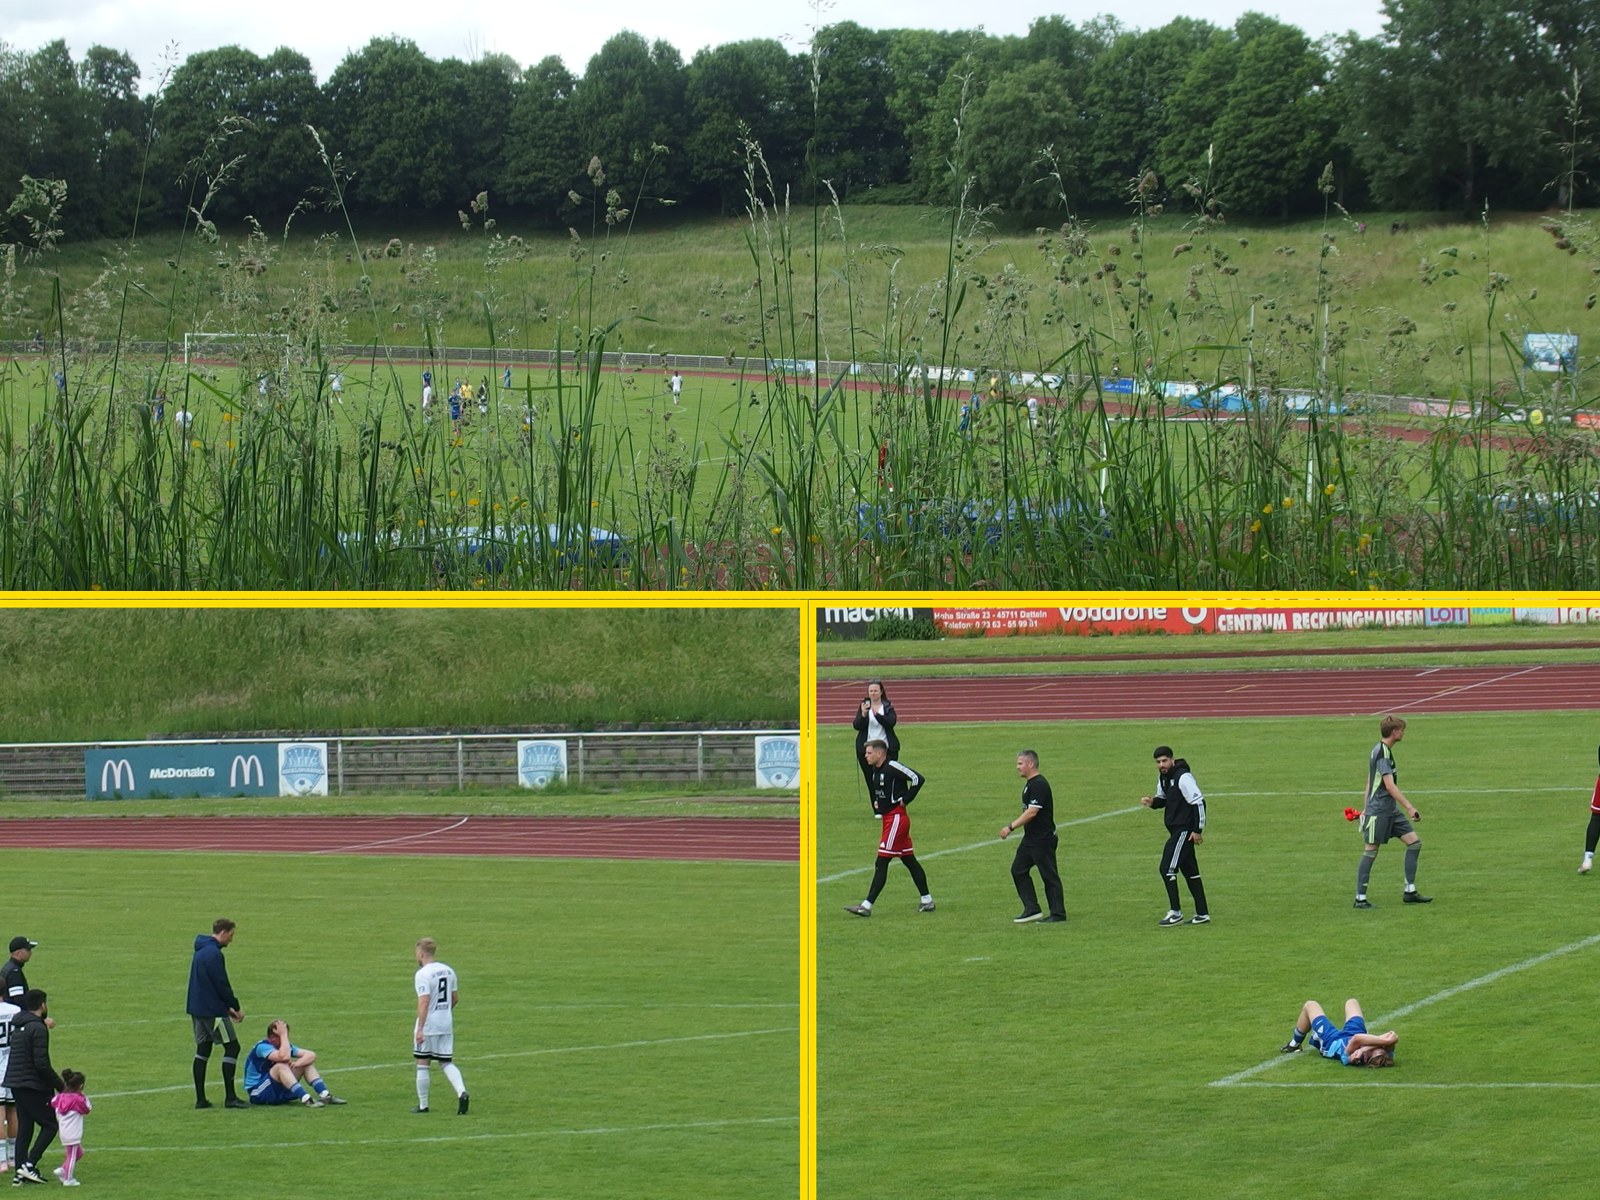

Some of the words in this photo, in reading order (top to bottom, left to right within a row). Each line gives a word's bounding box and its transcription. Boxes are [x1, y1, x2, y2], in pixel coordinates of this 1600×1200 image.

[934, 612, 953, 620] Hohe
[955, 611, 980, 620] Straße
[982, 611, 991, 619] 23
[997, 611, 1018, 619] 45711
[1020, 610, 1047, 619] Datteln
[1217, 613, 1287, 632] CENTRUM
[1292, 609, 1424, 630] RECKLINGHAUSEN
[149, 766, 215, 779] McDonald's
[437, 977, 448, 1003] 9
